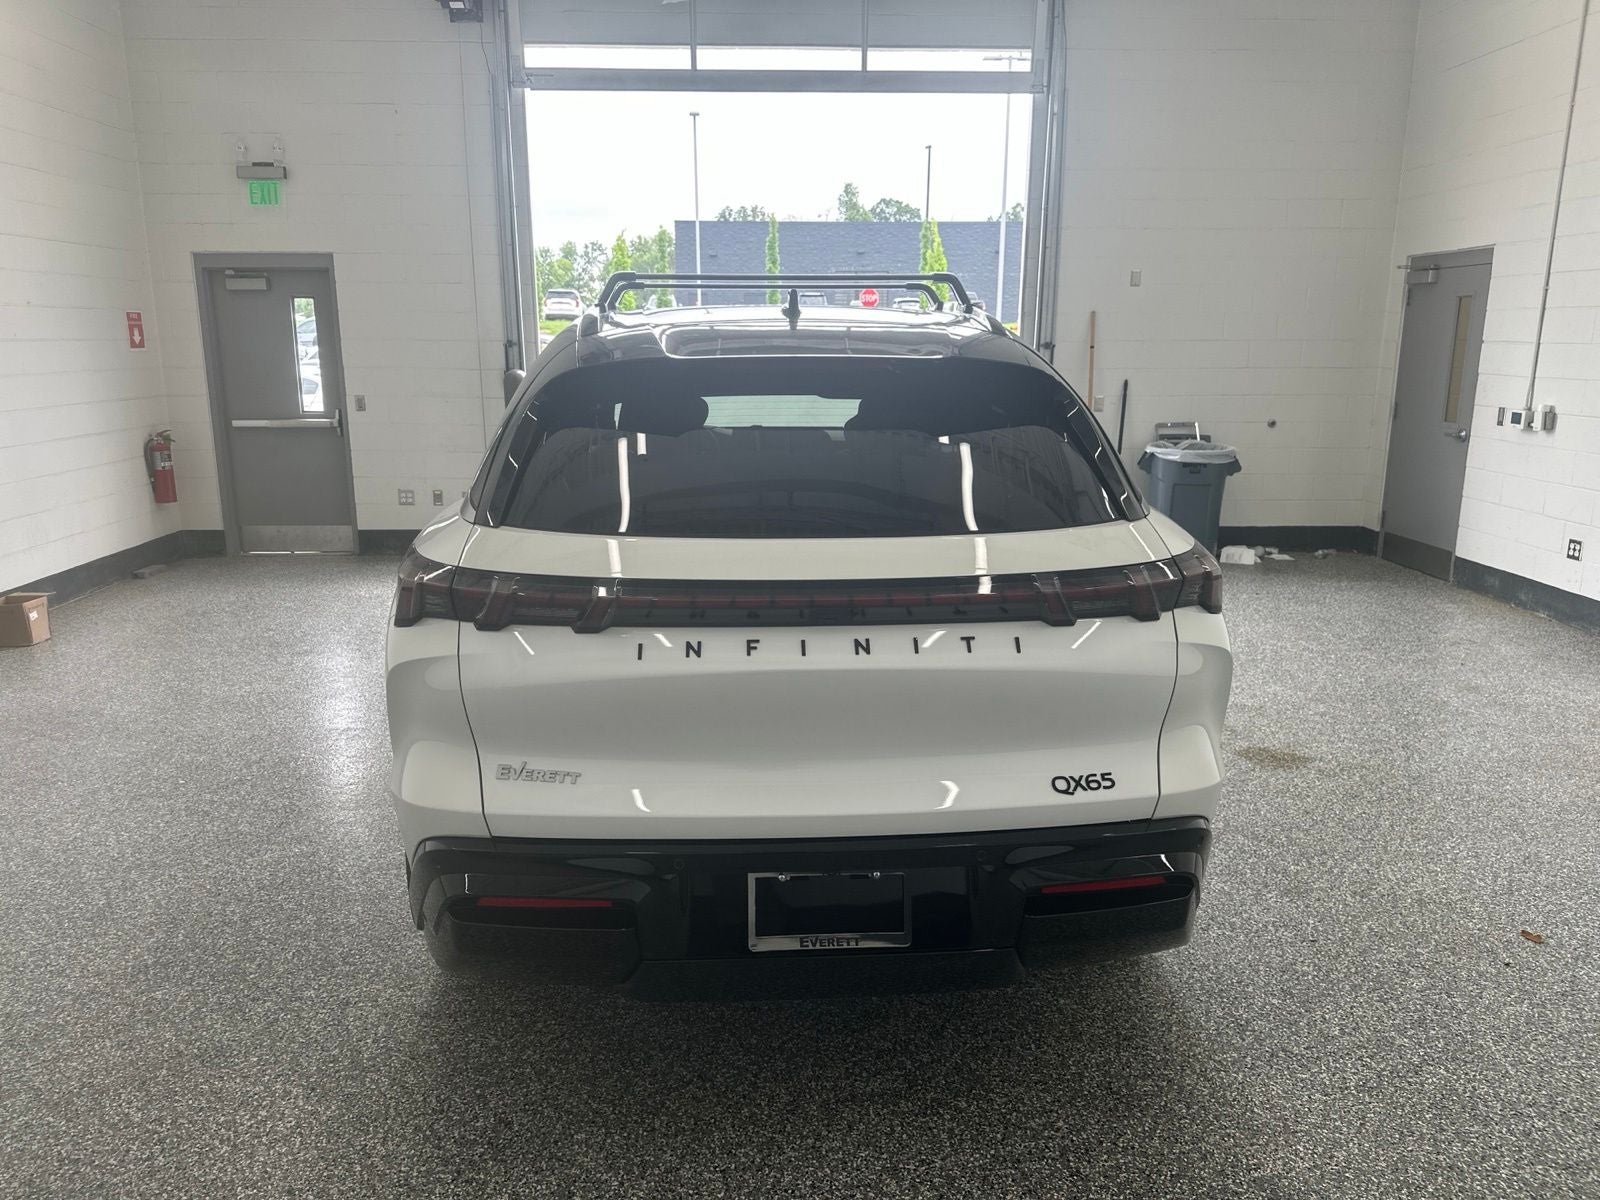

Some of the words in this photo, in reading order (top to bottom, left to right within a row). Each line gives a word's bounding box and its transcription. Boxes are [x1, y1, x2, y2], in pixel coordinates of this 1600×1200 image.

[250, 183, 279, 205] EXIT
[860, 294, 877, 303] STOP
[637, 636, 1022, 661] INFINITI
[496, 761, 582, 785] EVERETT
[1051, 772, 1116, 796] QX65
[799, 936, 862, 948] EVERETT
